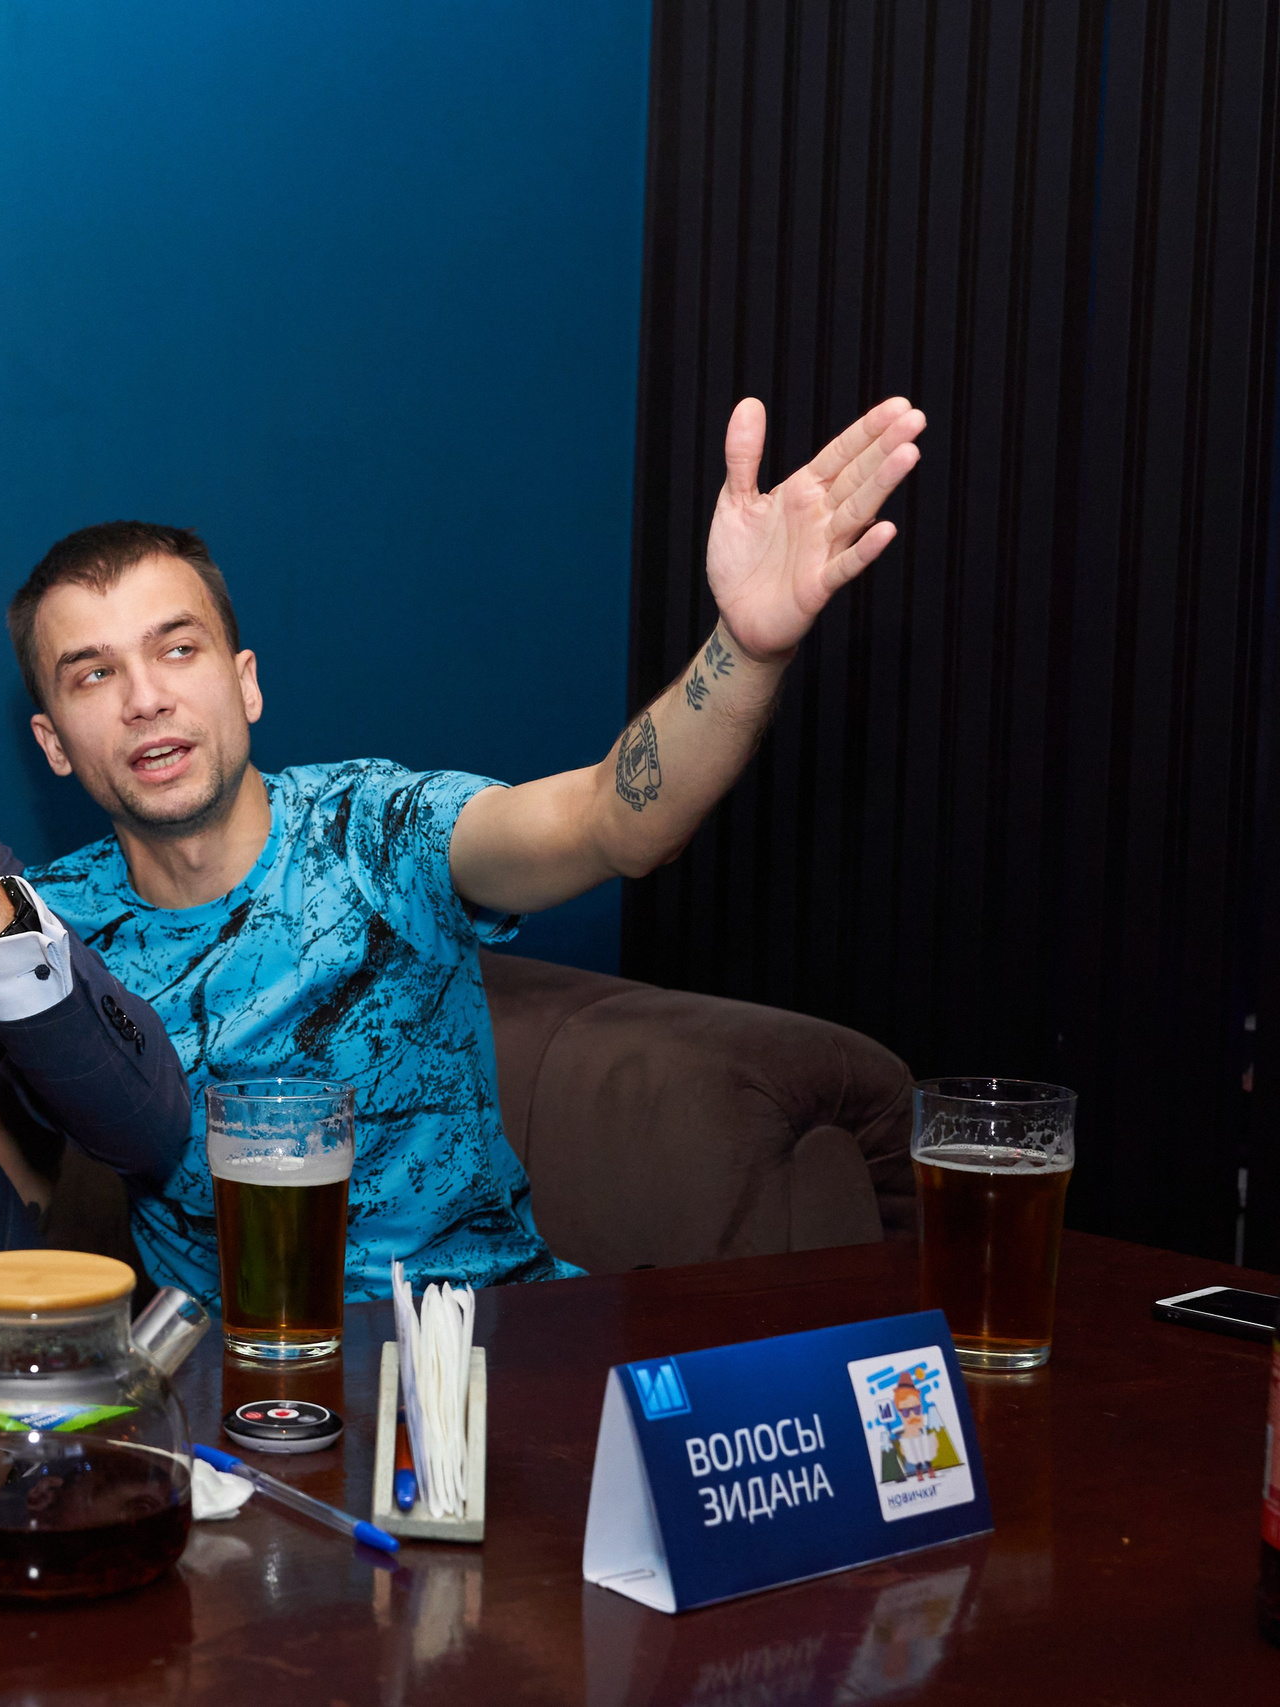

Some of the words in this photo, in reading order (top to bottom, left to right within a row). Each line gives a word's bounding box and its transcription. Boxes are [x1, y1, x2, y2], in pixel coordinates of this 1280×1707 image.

[644, 718, 658, 769] UNITED
[686, 1413, 825, 1477] ВОЛОСЫ
[698, 1463, 834, 1527] ЗИДАНА
